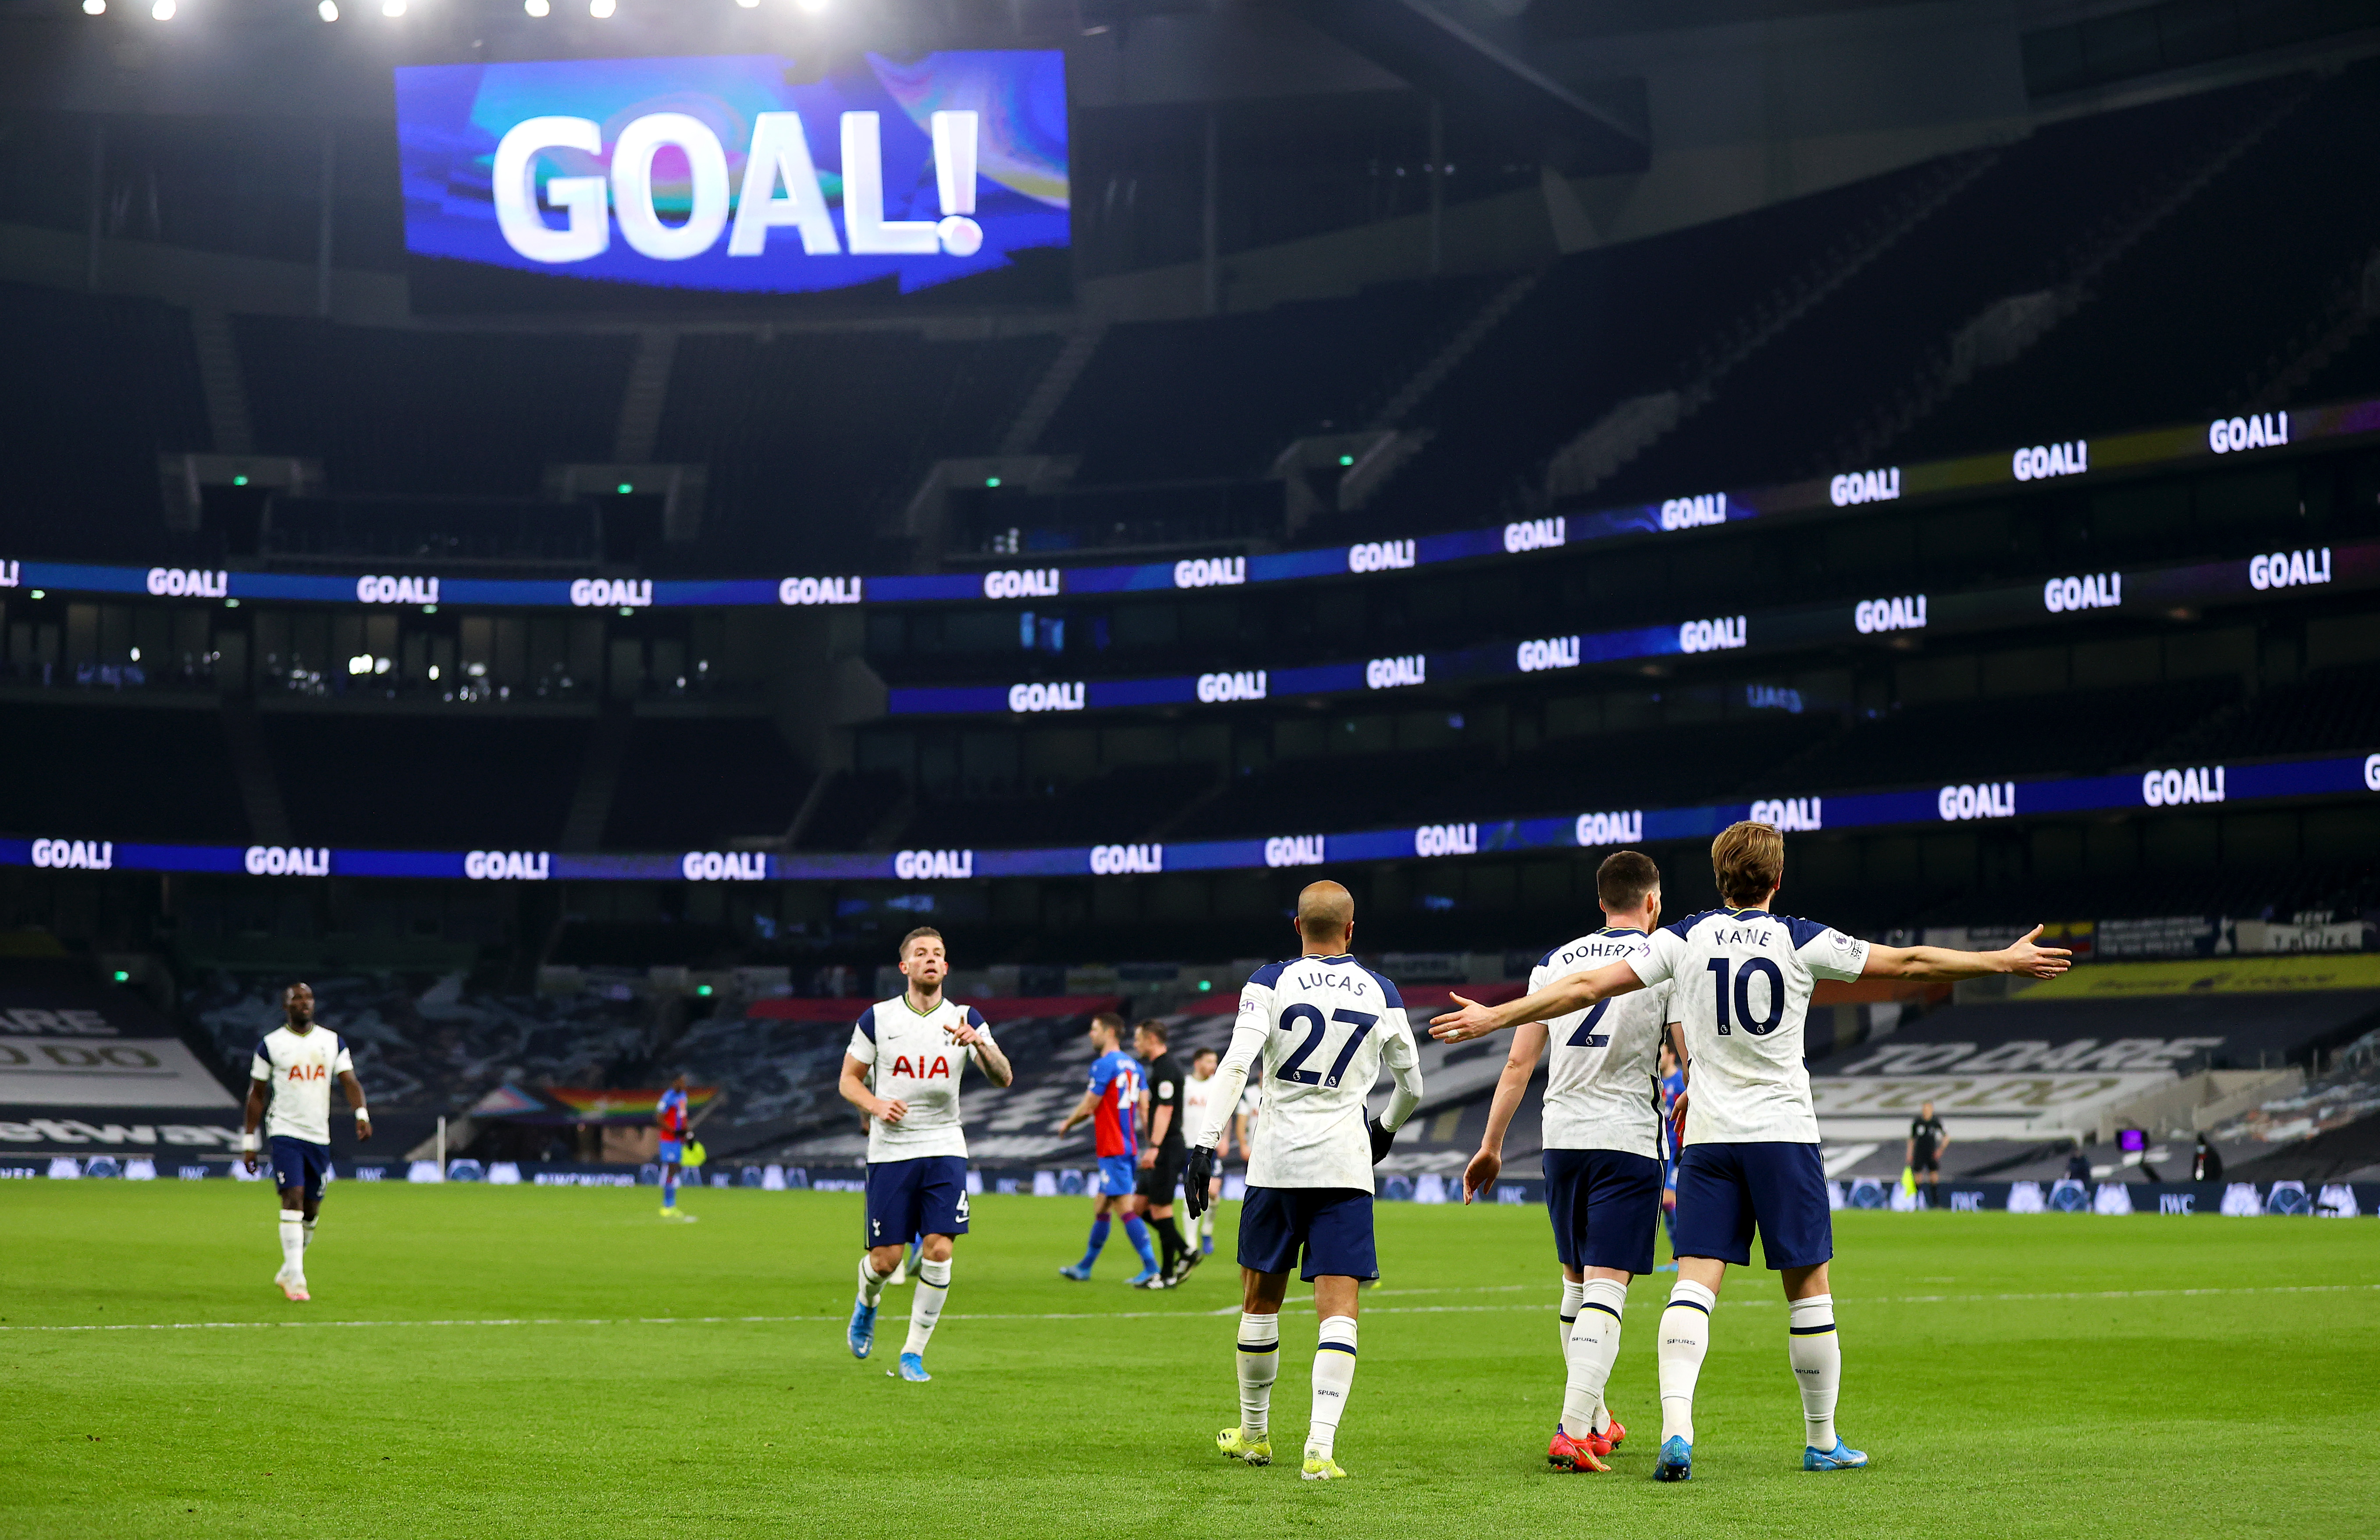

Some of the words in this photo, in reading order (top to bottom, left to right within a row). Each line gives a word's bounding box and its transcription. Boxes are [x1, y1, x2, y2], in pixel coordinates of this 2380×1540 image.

[492, 110, 983, 263] GOAL!
[2209, 411, 2288, 454] GOAL!
[2013, 440, 2087, 481] GOAL!
[1830, 468, 1900, 507] GOAL!
[1661, 492, 1726, 530] GOAL!
[1504, 517, 1565, 553] GOAL!
[1174, 557, 1245, 589] GOAL!
[1349, 539, 1415, 573] GOAL!
[2250, 548, 2330, 590] GOAL!
[146, 568, 228, 598] GOAL!
[356, 576, 439, 605] GOAL!
[570, 579, 652, 607] GOAL!
[779, 576, 861, 605] GOAL!
[984, 569, 1059, 599] GOAL!
[2045, 572, 2121, 612] GOAL!
[1855, 595, 1926, 633] GOAL!
[1679, 616, 1746, 653] GOAL!
[1518, 636, 1580, 672] GOAL!
[1198, 671, 1266, 703] GOAL!
[1367, 654, 1425, 689] GOAL!
[1009, 682, 1085, 712] GOAL!
[1939, 782, 2015, 821] GOAL!
[2143, 766, 2225, 806] GOAL!
[1576, 811, 1642, 846] GOAL!
[1750, 797, 1822, 832] GOAL!
[32, 839, 112, 870] GOAL!
[1265, 835, 1324, 868] GOAL!
[1416, 823, 1477, 857] GOAL!
[245, 846, 329, 876] GOAL!
[465, 851, 549, 879] GOAL!
[683, 852, 766, 881] GOAL!
[895, 850, 972, 879] GOAL!
[1090, 844, 1162, 875] GOAL!
[1562, 943, 1635, 965] DOHERT
[1715, 929, 1772, 947] KANE
[1298, 973, 1367, 996] LUCAS
[1707, 957, 1785, 1035] 10
[1565, 997, 1612, 1047] 2
[1275, 1003, 1379, 1088] 27
[288, 1064, 326, 1081] AIA
[893, 1055, 949, 1078] AIA
[1115, 1072, 1140, 1110] 24
[956, 1190, 969, 1216] 4
